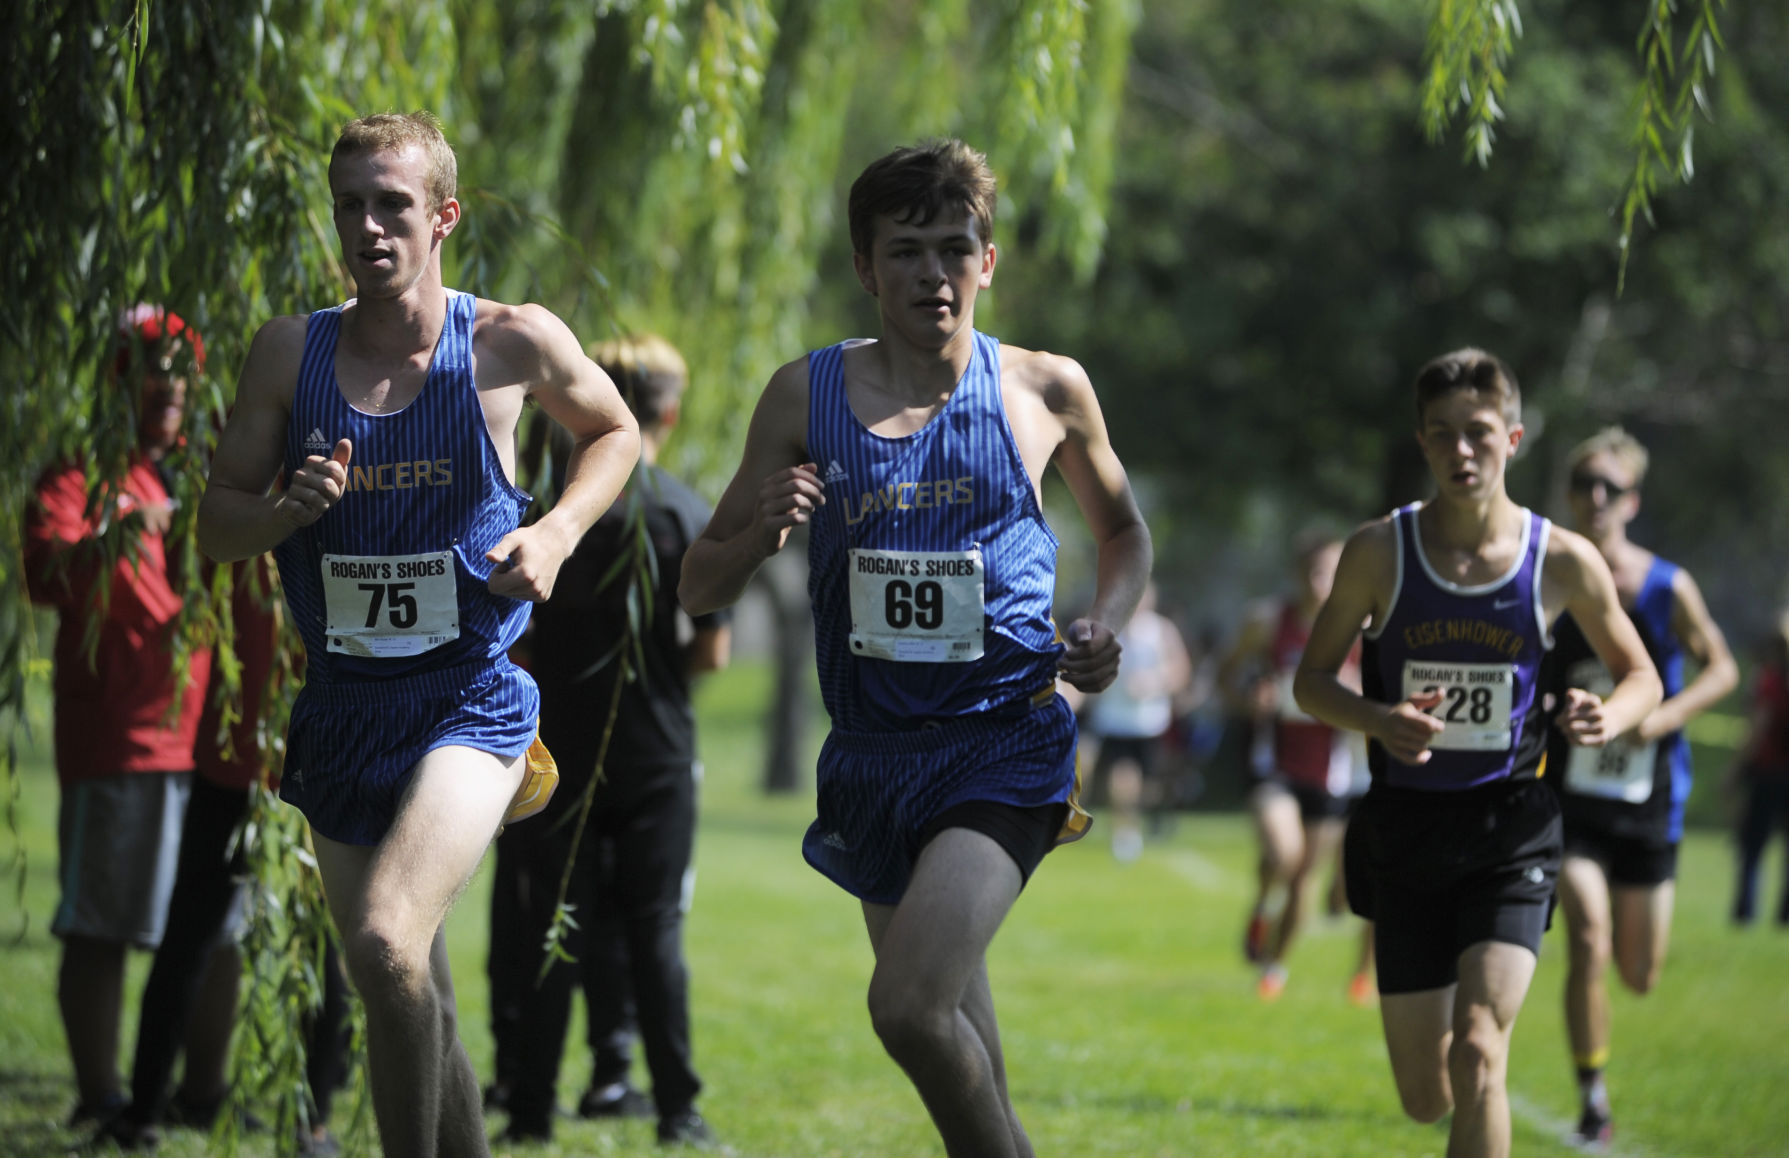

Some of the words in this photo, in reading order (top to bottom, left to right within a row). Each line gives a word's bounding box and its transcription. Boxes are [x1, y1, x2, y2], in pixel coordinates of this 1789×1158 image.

[304, 441, 331, 449] adidas
[344, 458, 452, 491] NCERS
[843, 476, 974, 526] LANCERS
[331, 561, 391, 579] ROGAN'S
[396, 559, 446, 577] SHOES
[857, 556, 920, 576] ROGAN'S
[926, 560, 974, 577] SHOES
[358, 582, 418, 629] 75
[885, 579, 944, 630] 69
[1404, 618, 1525, 657] EISENHOWER
[1412, 668, 1463, 682] ROGAN'S
[1468, 670, 1505, 684] SHOES
